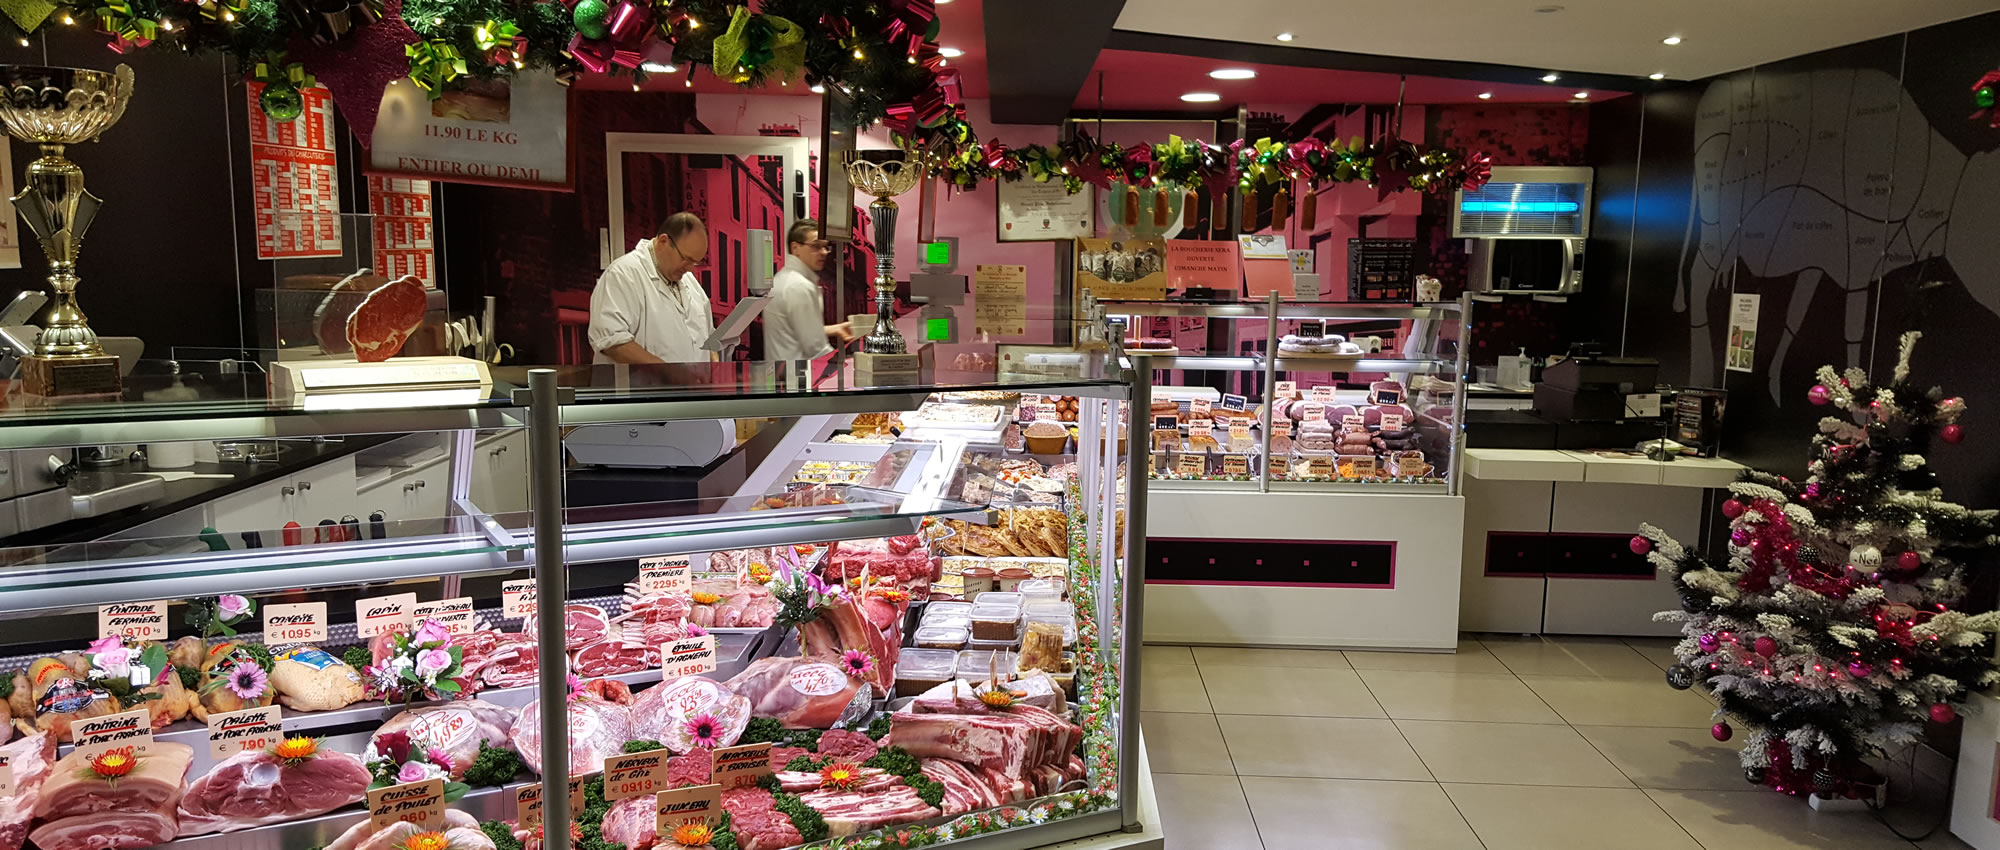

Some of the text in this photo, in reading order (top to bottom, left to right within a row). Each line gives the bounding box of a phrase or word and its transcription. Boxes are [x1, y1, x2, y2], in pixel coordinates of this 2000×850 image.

[425, 124, 518, 145] 11.90 LE KG
[398, 157, 541, 181] ENTIER OU DEMI
[102, 603, 155, 614] PINTADE
[366, 603, 402, 617] LAPIN
[80, 717, 140, 733] POITRINE
[214, 712, 269, 728] PALETTE
[75, 738, 87, 747] de
[88, 734, 112, 745] PORC
[210, 732, 222, 741] de
[223, 729, 245, 739] PORC
[615, 756, 660, 770] NERVEUX
[727, 759, 769, 772] BRAISER
[610, 773, 624, 782] de
[380, 785, 429, 802] CUISSE
[374, 795, 440, 816] de POULET
[660, 800, 710, 815] JUMEAU
